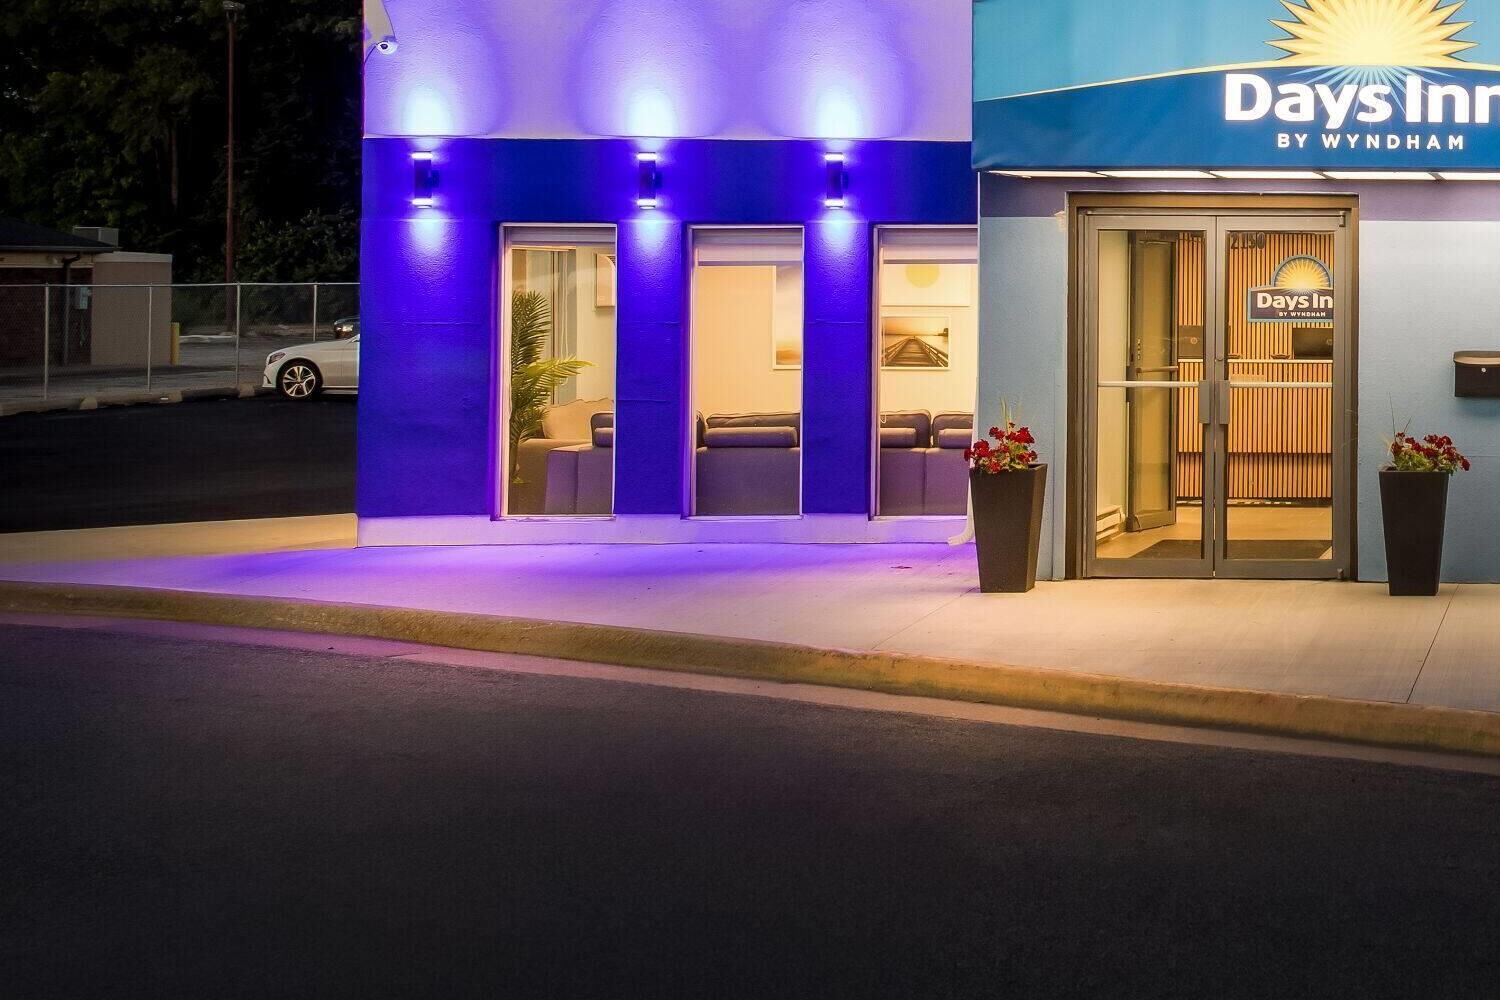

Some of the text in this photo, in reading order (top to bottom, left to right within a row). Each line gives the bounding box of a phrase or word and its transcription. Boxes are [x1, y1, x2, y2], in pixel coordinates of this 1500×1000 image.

[1224, 73, 1393, 129] Days
[1277, 133, 1464, 150] BY WYNDHAM
[1256, 292, 1334, 311] Days In
